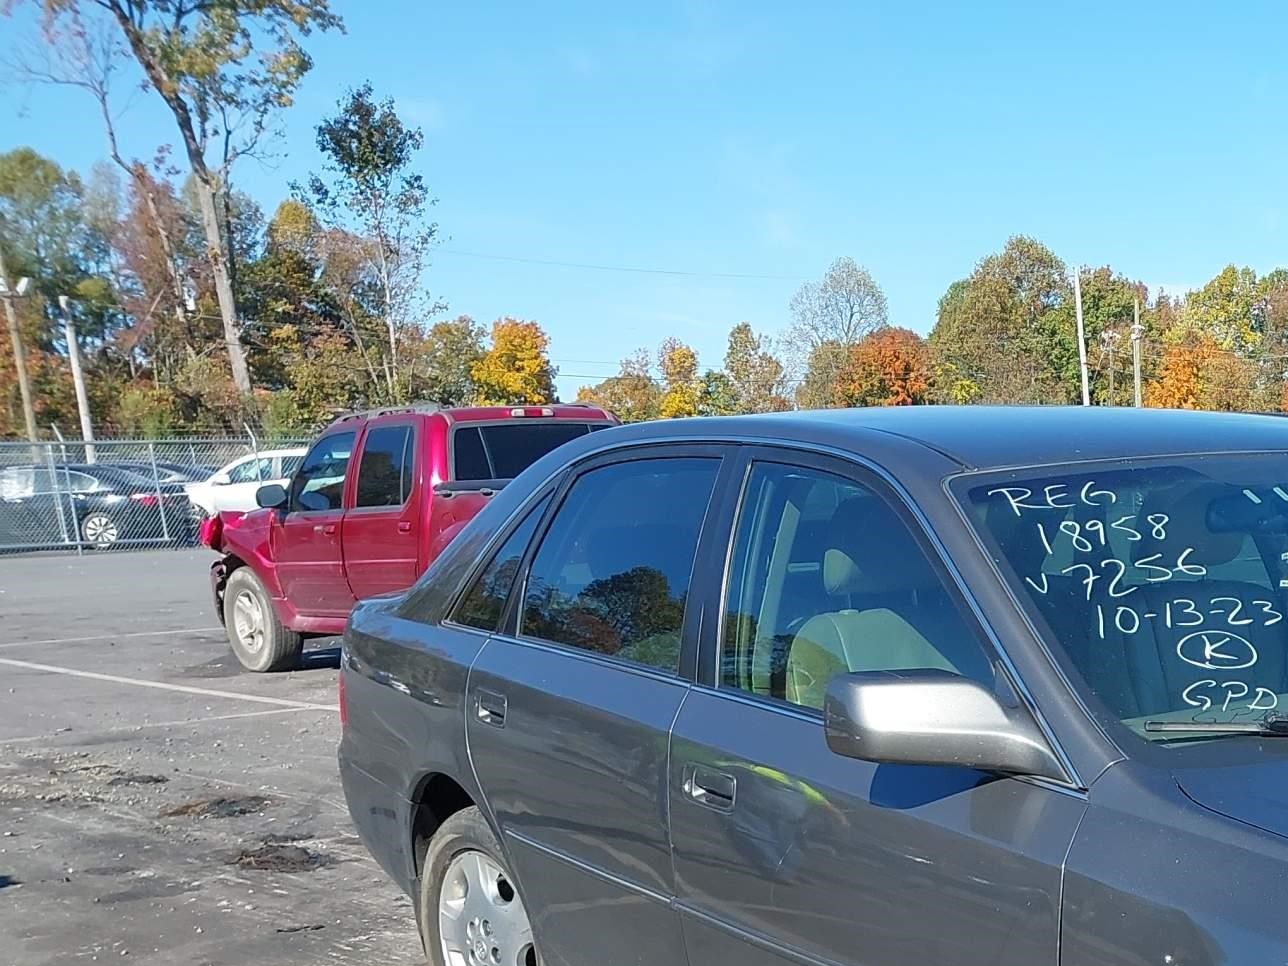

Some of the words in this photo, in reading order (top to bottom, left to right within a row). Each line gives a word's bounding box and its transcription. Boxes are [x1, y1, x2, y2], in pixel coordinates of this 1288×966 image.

[988, 481, 1117, 517] REG
[1037, 513, 1170, 555] 18958
[1063, 547, 1208, 600] 7256
[1097, 597, 1283, 639] 10-13-23
[1202, 635, 1238, 660] K
[1182, 679, 1278, 712] GPD
